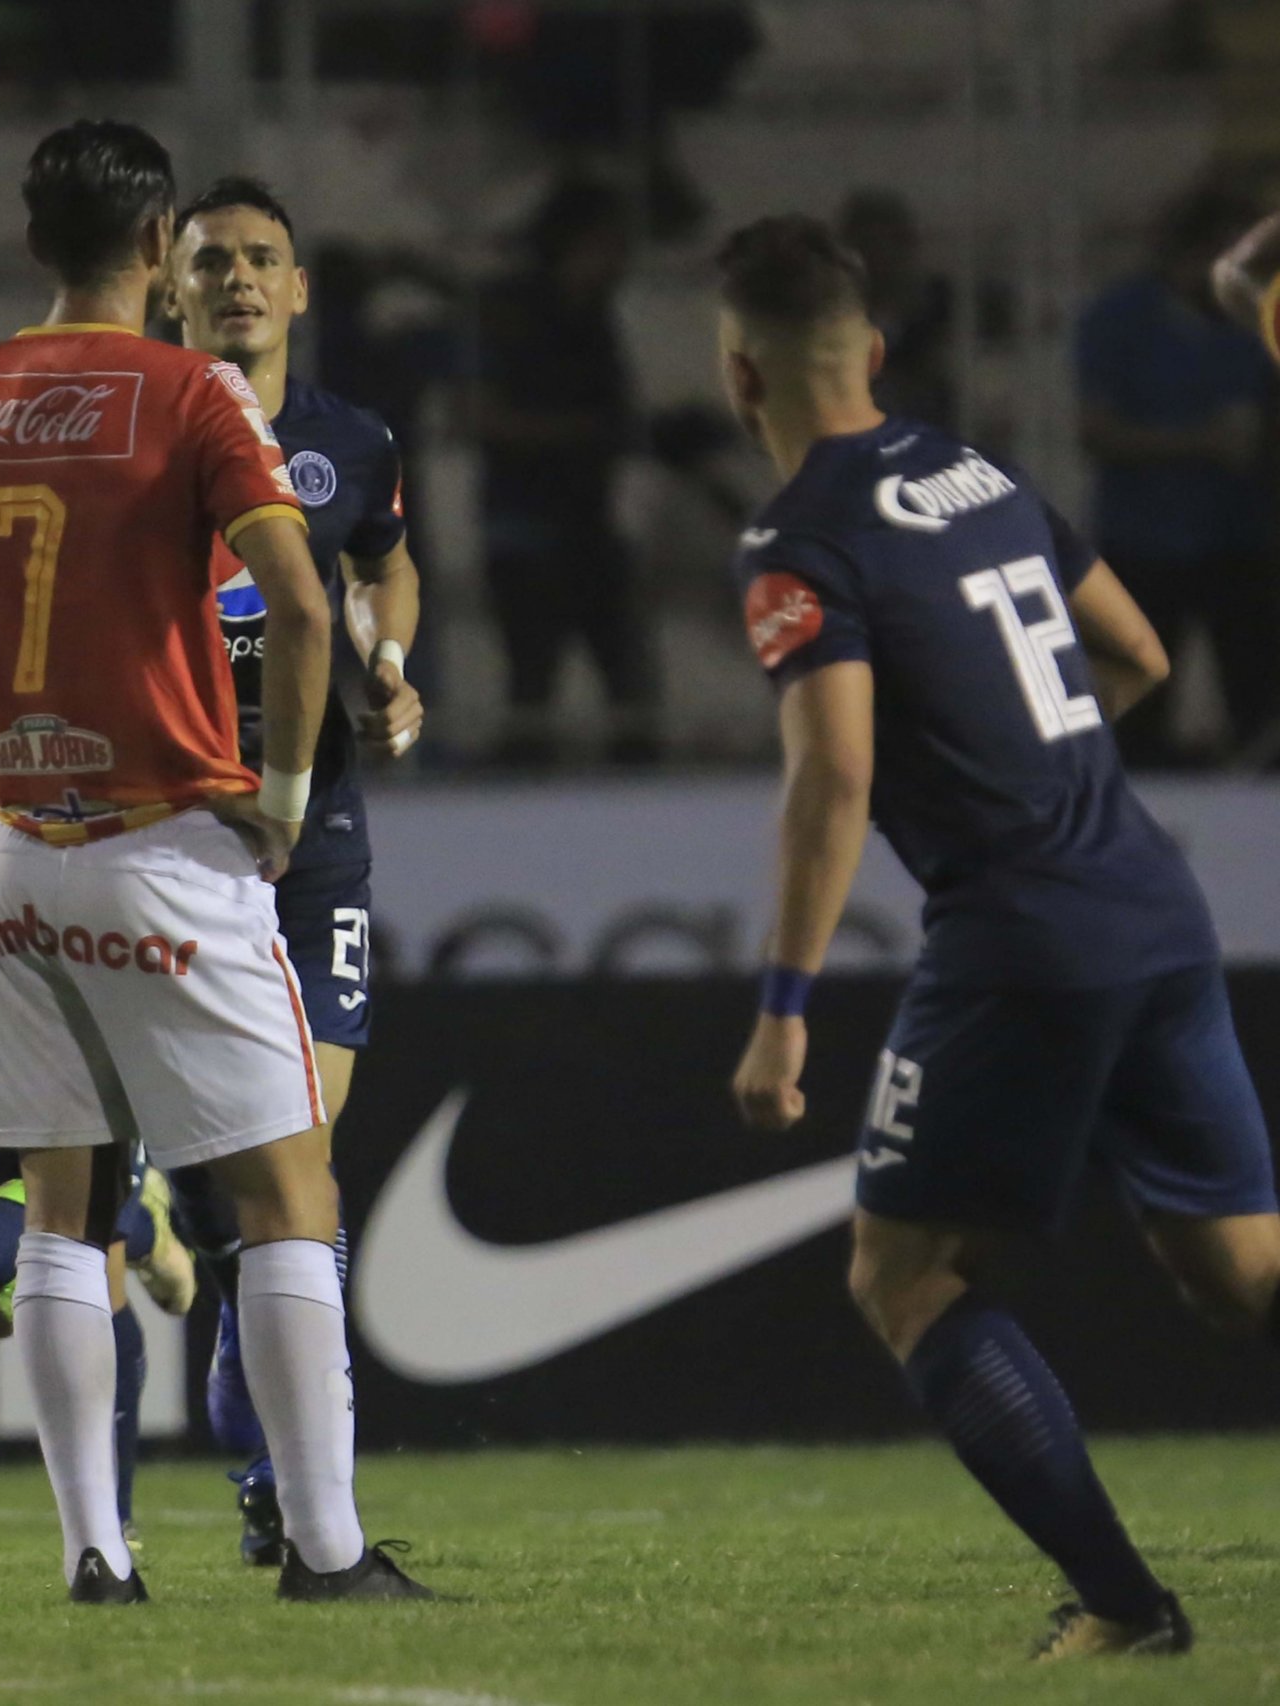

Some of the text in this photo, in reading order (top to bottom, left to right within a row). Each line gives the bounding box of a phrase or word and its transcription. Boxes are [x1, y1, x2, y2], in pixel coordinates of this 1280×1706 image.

[222, 635, 266, 662] eps
[959, 555, 1103, 742] 12
[332, 908, 369, 981] 2
[870, 1048, 923, 1140] 12
